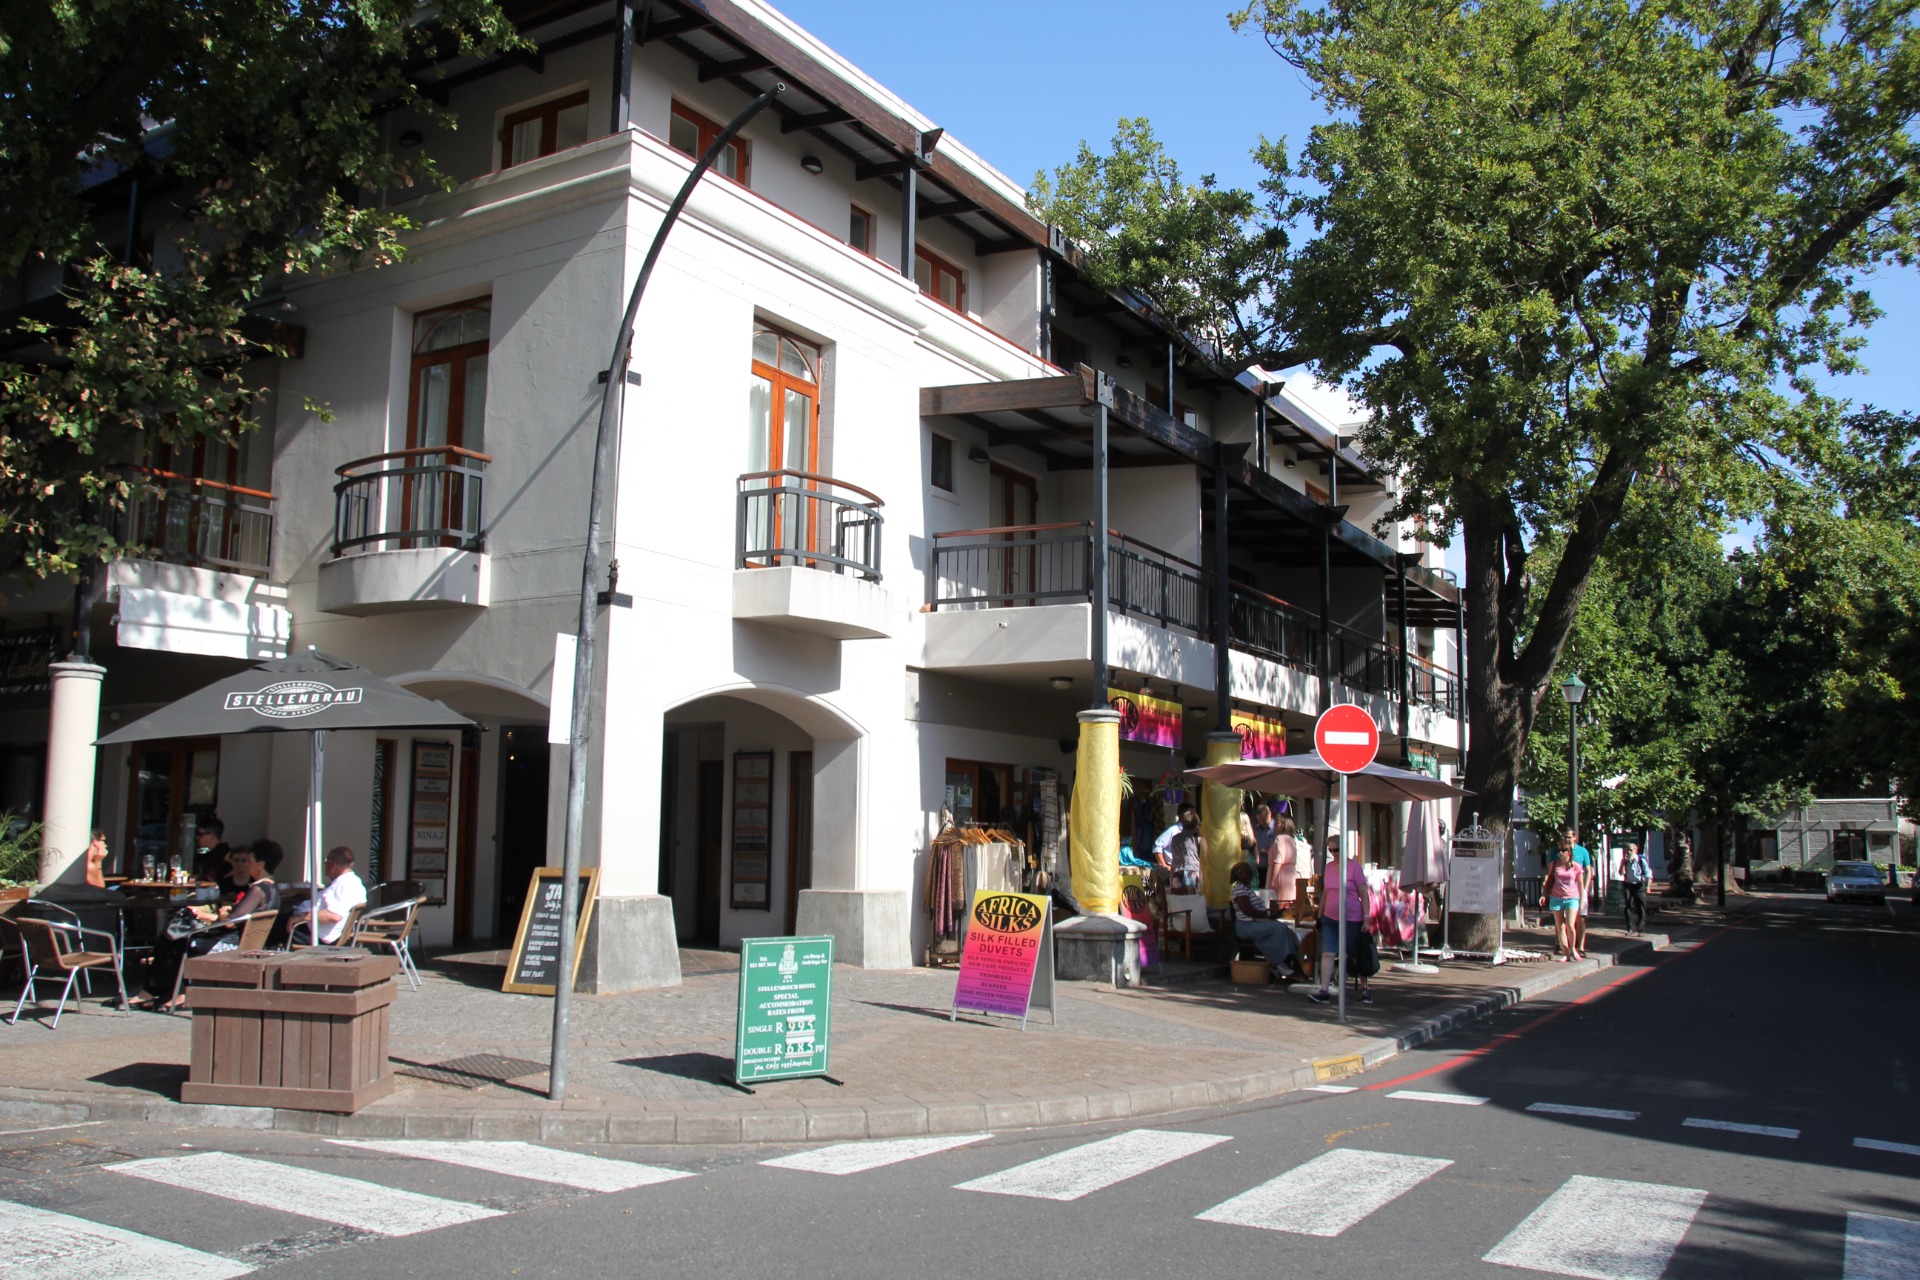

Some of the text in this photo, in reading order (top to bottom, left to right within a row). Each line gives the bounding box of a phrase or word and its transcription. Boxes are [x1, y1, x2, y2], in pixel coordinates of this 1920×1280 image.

[232, 690, 356, 707] STELLENBRAU
[262, 705, 320, 716] SOUTH AFRICA
[545, 884, 563, 901] JA
[977, 896, 1037, 918] AFRICA
[980, 912, 1033, 933] SILKS
[970, 932, 1036, 948] SILK FILLED
[979, 943, 1023, 957] DUVETS
[980, 956, 1002, 964] SERICIN
[1003, 959, 1031, 968] ENRICHED
[997, 965, 1028, 973] PRODUCTS
[979, 972, 1012, 981] PASHMINAS
[758, 984, 798, 992] STELLENBOSCH
[980, 982, 1007, 990] SCARVES
[975, 990, 995, 998] WOVEN
[995, 993, 1025, 1002] PRODUCTS
[759, 1000, 813, 1009] ACCOMMODATION
[958, 1000, 1023, 1013] www.africasilks.com
[767, 1007, 805, 1016] RATES FROM
[747, 1020, 813, 1034] SINGLE R 995
[743, 1046, 772, 1055] DOUBLE
[774, 1043, 783, 1055] R
[786, 1041, 813, 1053] 685
[753, 1064, 764, 1076] jan
[781, 1057, 812, 1069] restaurant
